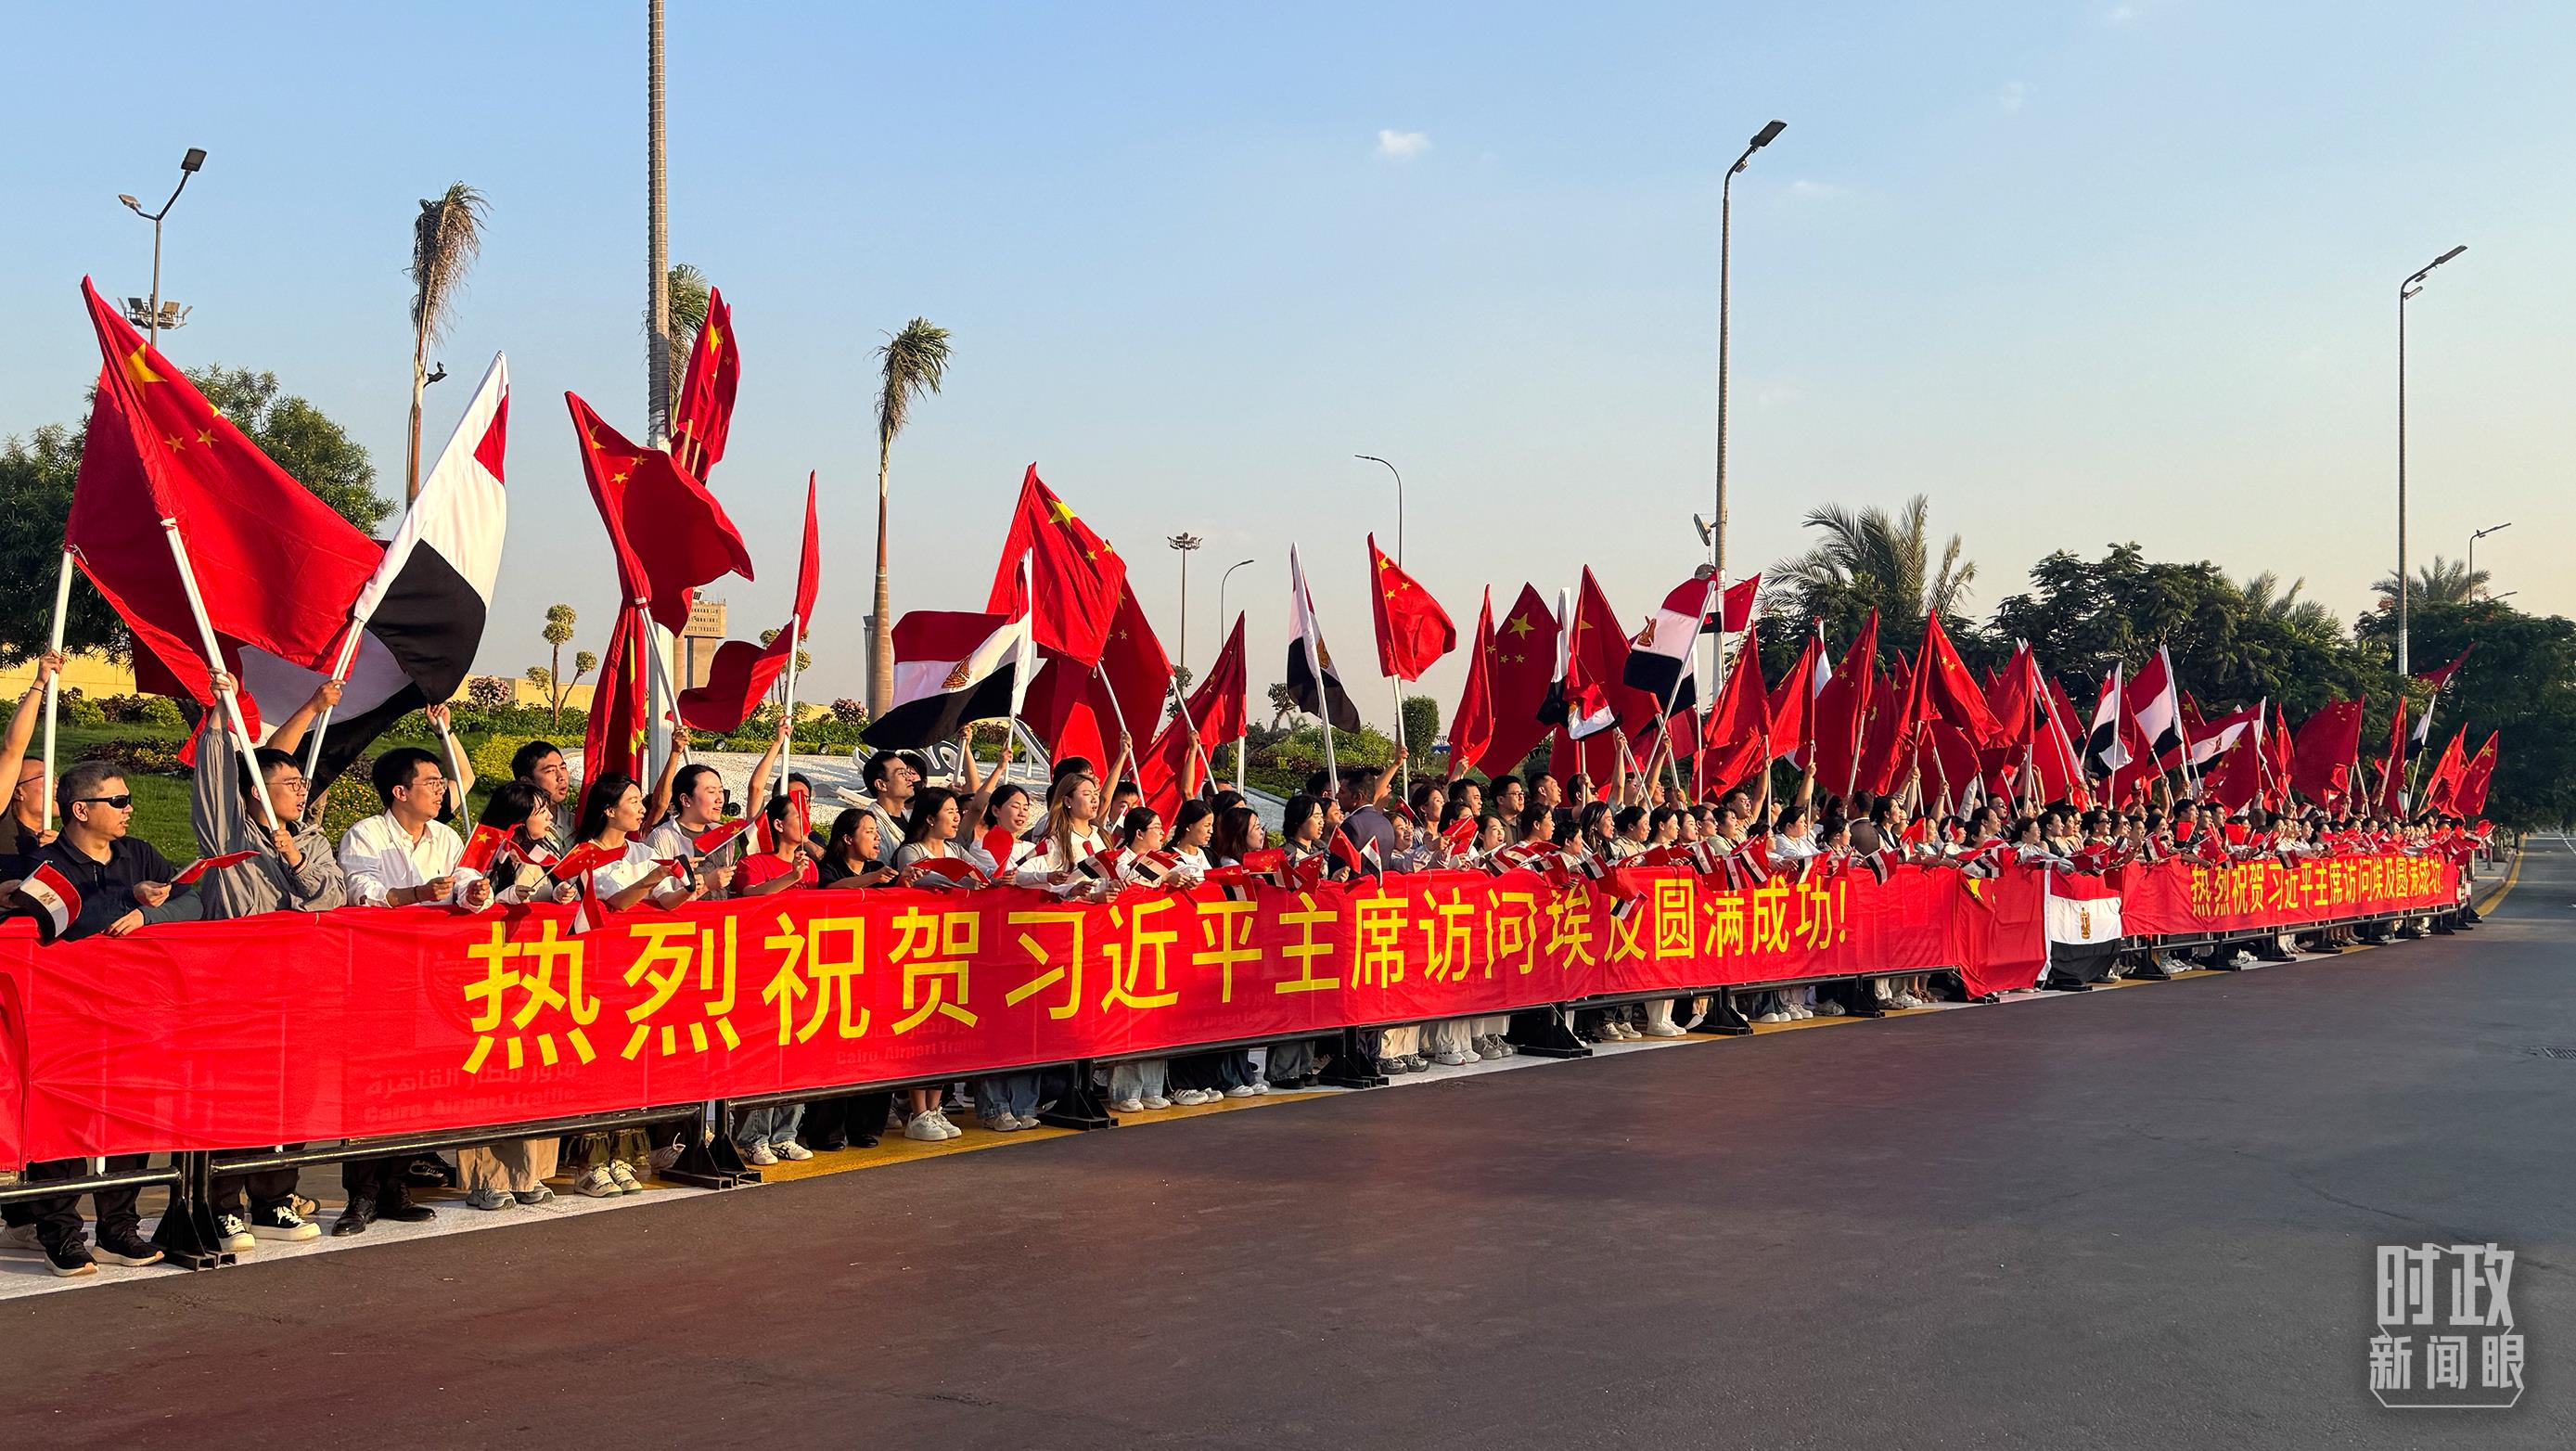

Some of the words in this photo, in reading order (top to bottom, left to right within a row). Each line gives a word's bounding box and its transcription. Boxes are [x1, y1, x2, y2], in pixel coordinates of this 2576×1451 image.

[462, 876, 1846, 1074] 热烈祝贺习近平主席访问埃及圆满成功!
